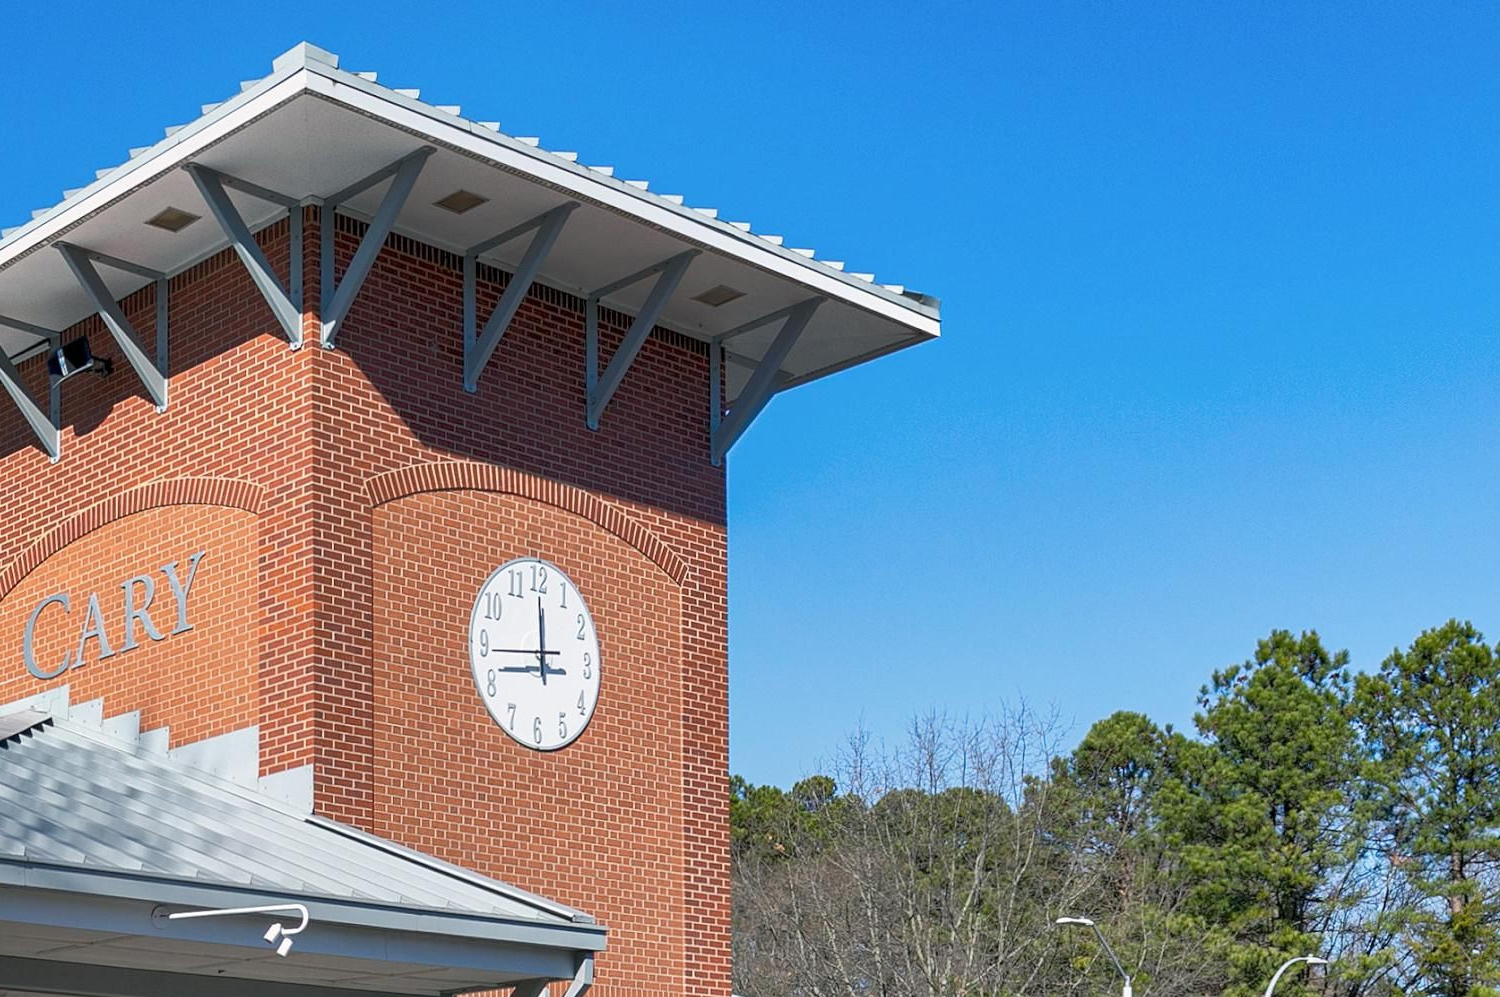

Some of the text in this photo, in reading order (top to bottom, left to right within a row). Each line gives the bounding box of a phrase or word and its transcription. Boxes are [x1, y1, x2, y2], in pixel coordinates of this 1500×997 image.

[508, 569, 524, 598] 11
[530, 565, 547, 595] 12
[485, 592, 502, 621] 10
[559, 582, 568, 609] 1
[22, 550, 206, 680] CARY
[576, 613, 586, 641] 2
[480, 629, 489, 657] 9
[583, 652, 592, 680] 3
[487, 669, 497, 698] 8
[576, 689, 586, 716] 4
[507, 703, 517, 731] 7
[533, 717, 542, 744] 6
[559, 712, 568, 739] 5
